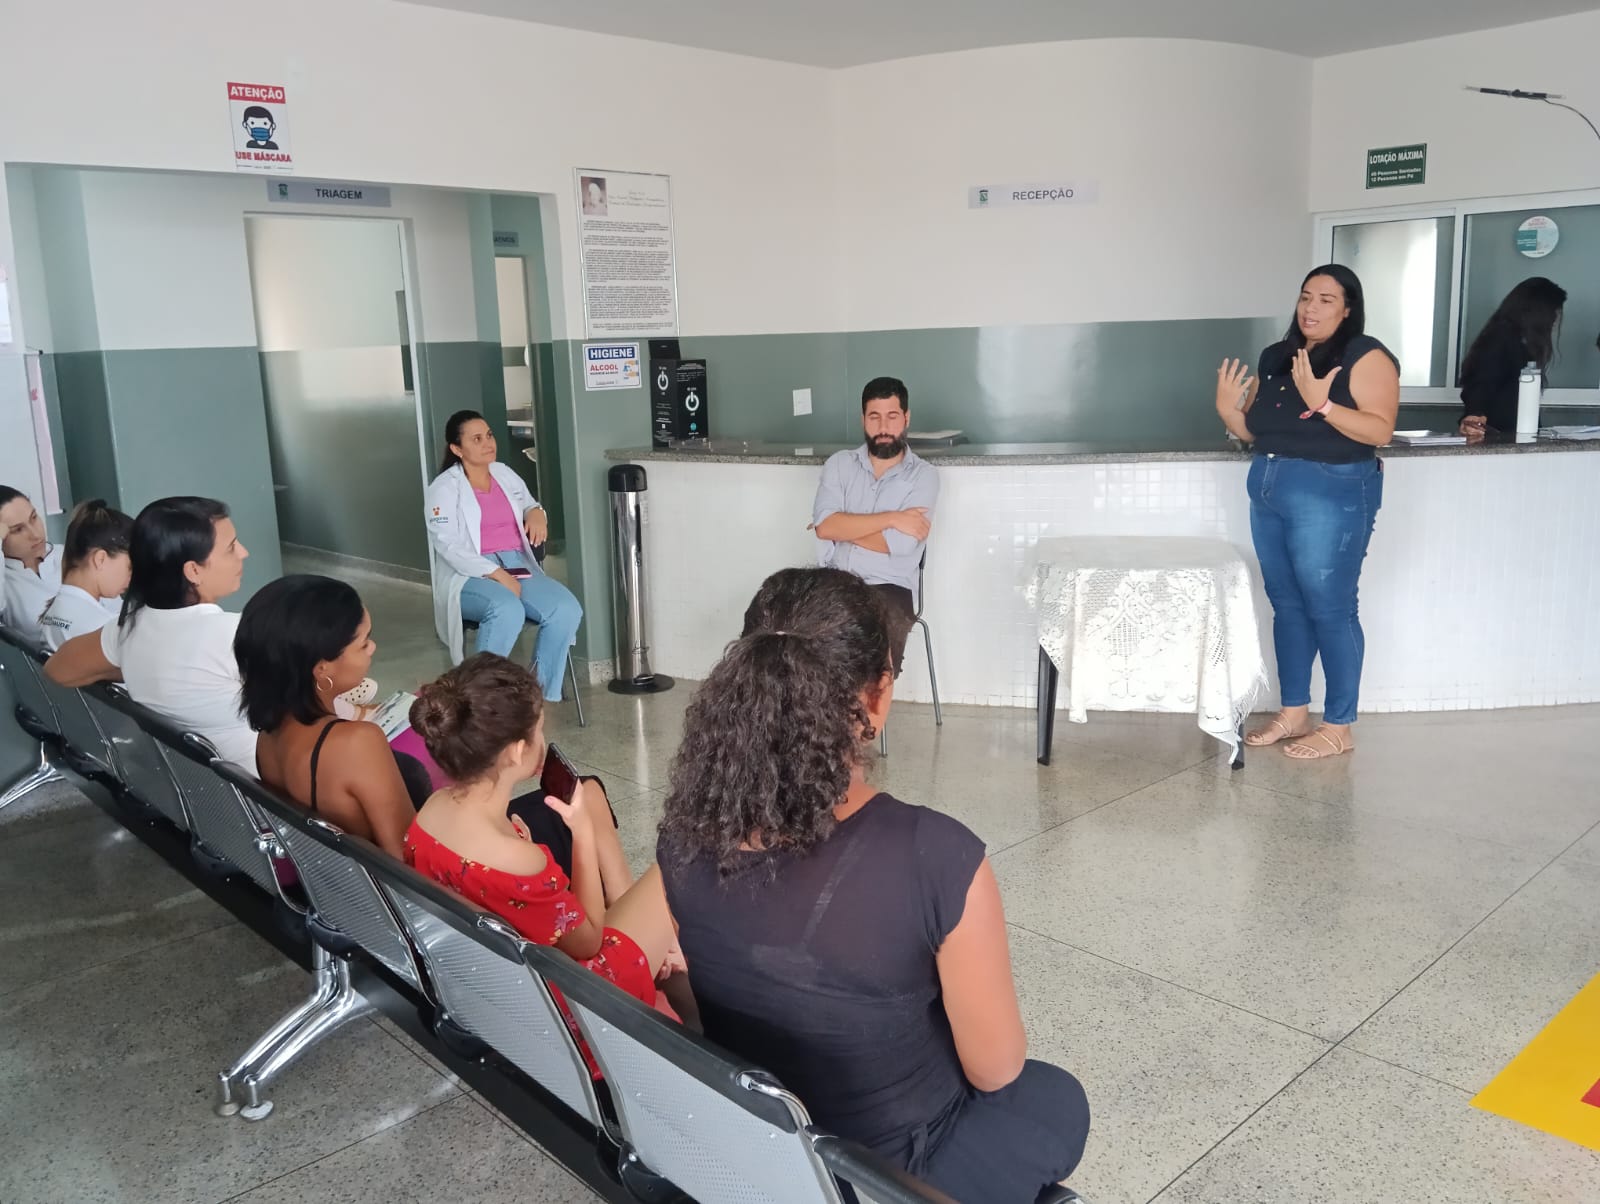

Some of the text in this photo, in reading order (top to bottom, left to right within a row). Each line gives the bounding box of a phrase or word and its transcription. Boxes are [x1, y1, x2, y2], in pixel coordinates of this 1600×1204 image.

[230, 86, 284, 100] ATENÇÃO
[235, 151, 292, 162] USE MÁSCARA
[1369, 149, 1424, 165] LOTAÇÃO MÁXIMA
[315, 188, 363, 199] TRIAGEM
[1012, 187, 1074, 200] RECEPÇÃO
[590, 348, 633, 359] HIGIENE
